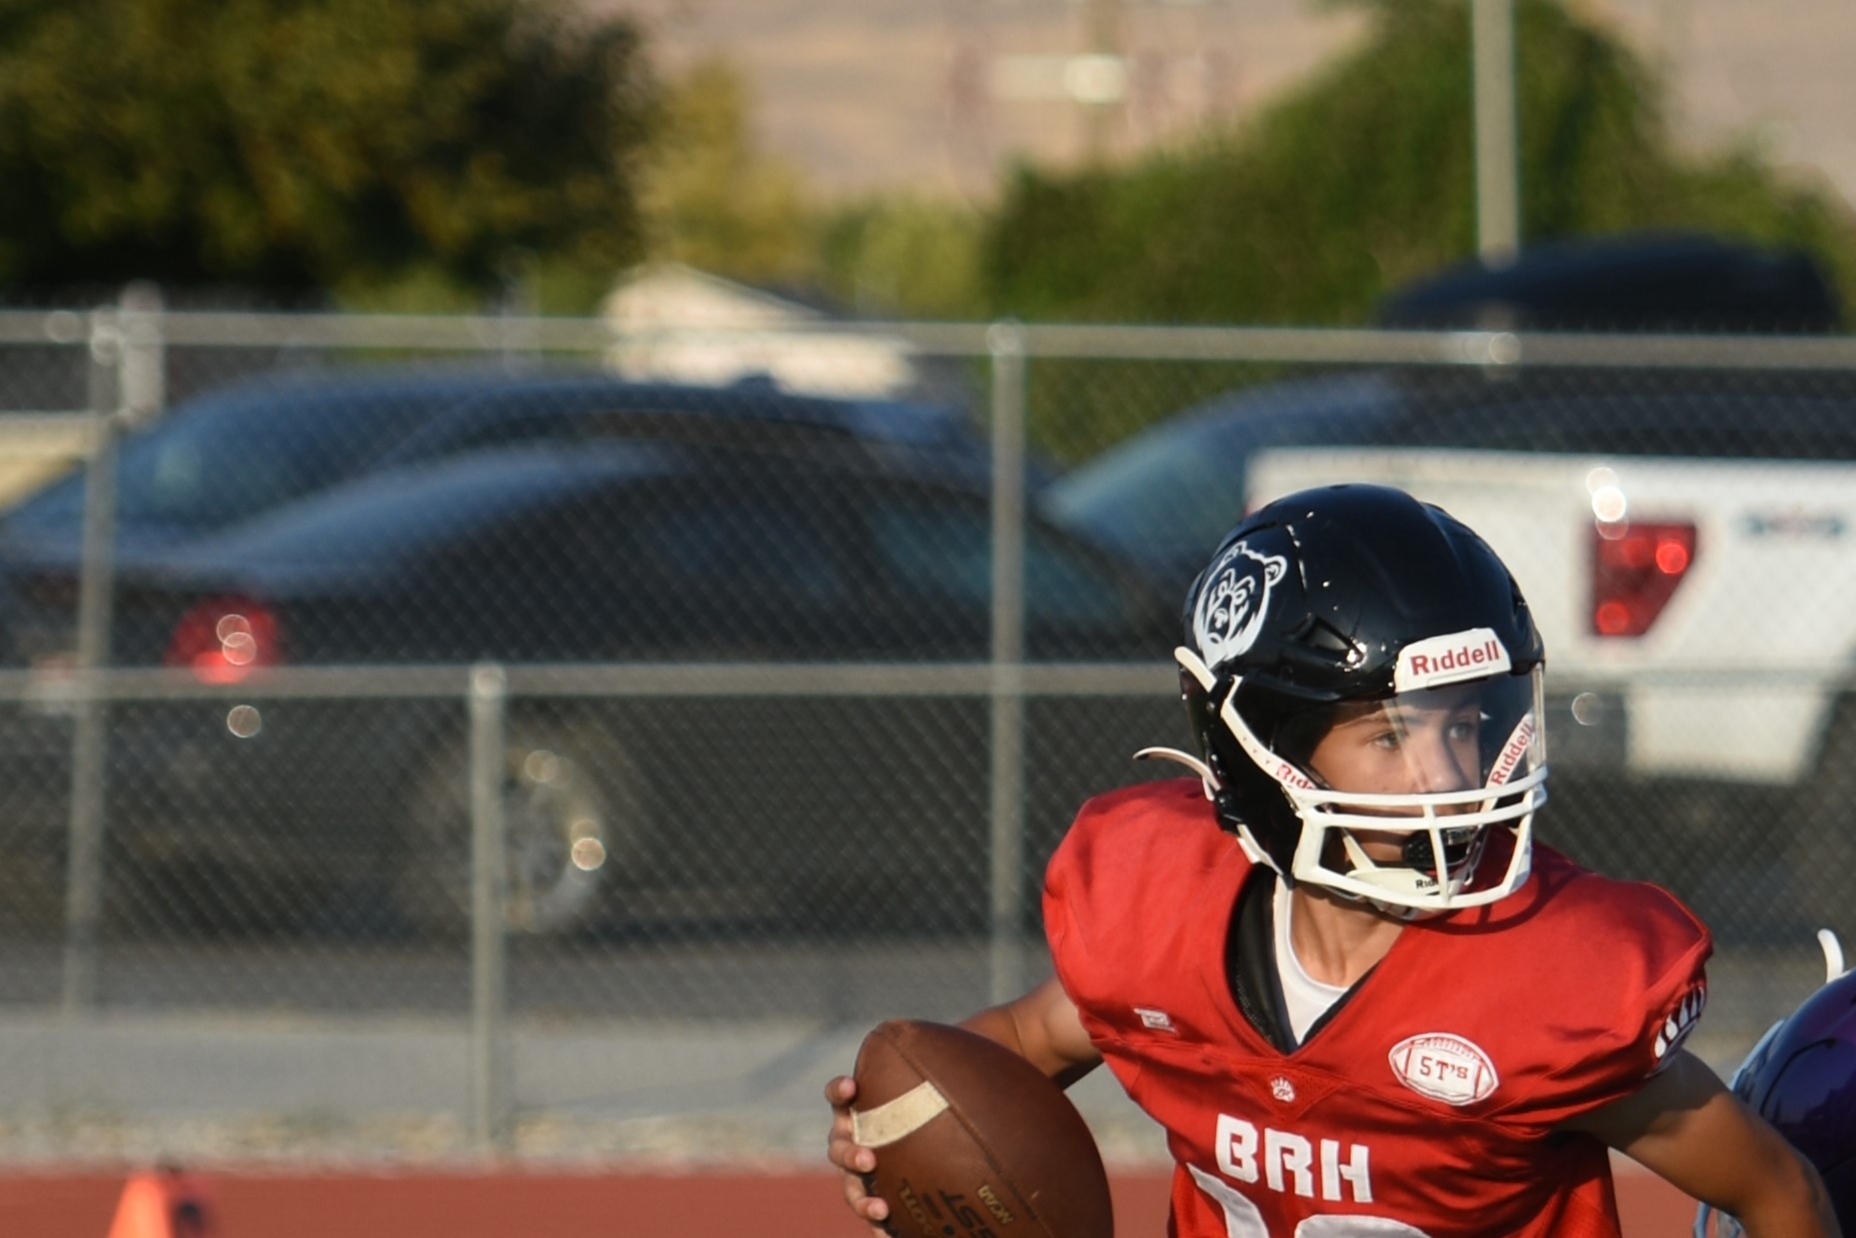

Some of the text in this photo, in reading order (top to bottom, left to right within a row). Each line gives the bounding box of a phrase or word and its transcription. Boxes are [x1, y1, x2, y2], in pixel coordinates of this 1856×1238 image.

[1410, 640, 1500, 676] Riddell
[1215, 1113, 1374, 1203] BRH
[977, 1184, 1014, 1224] NCAA
